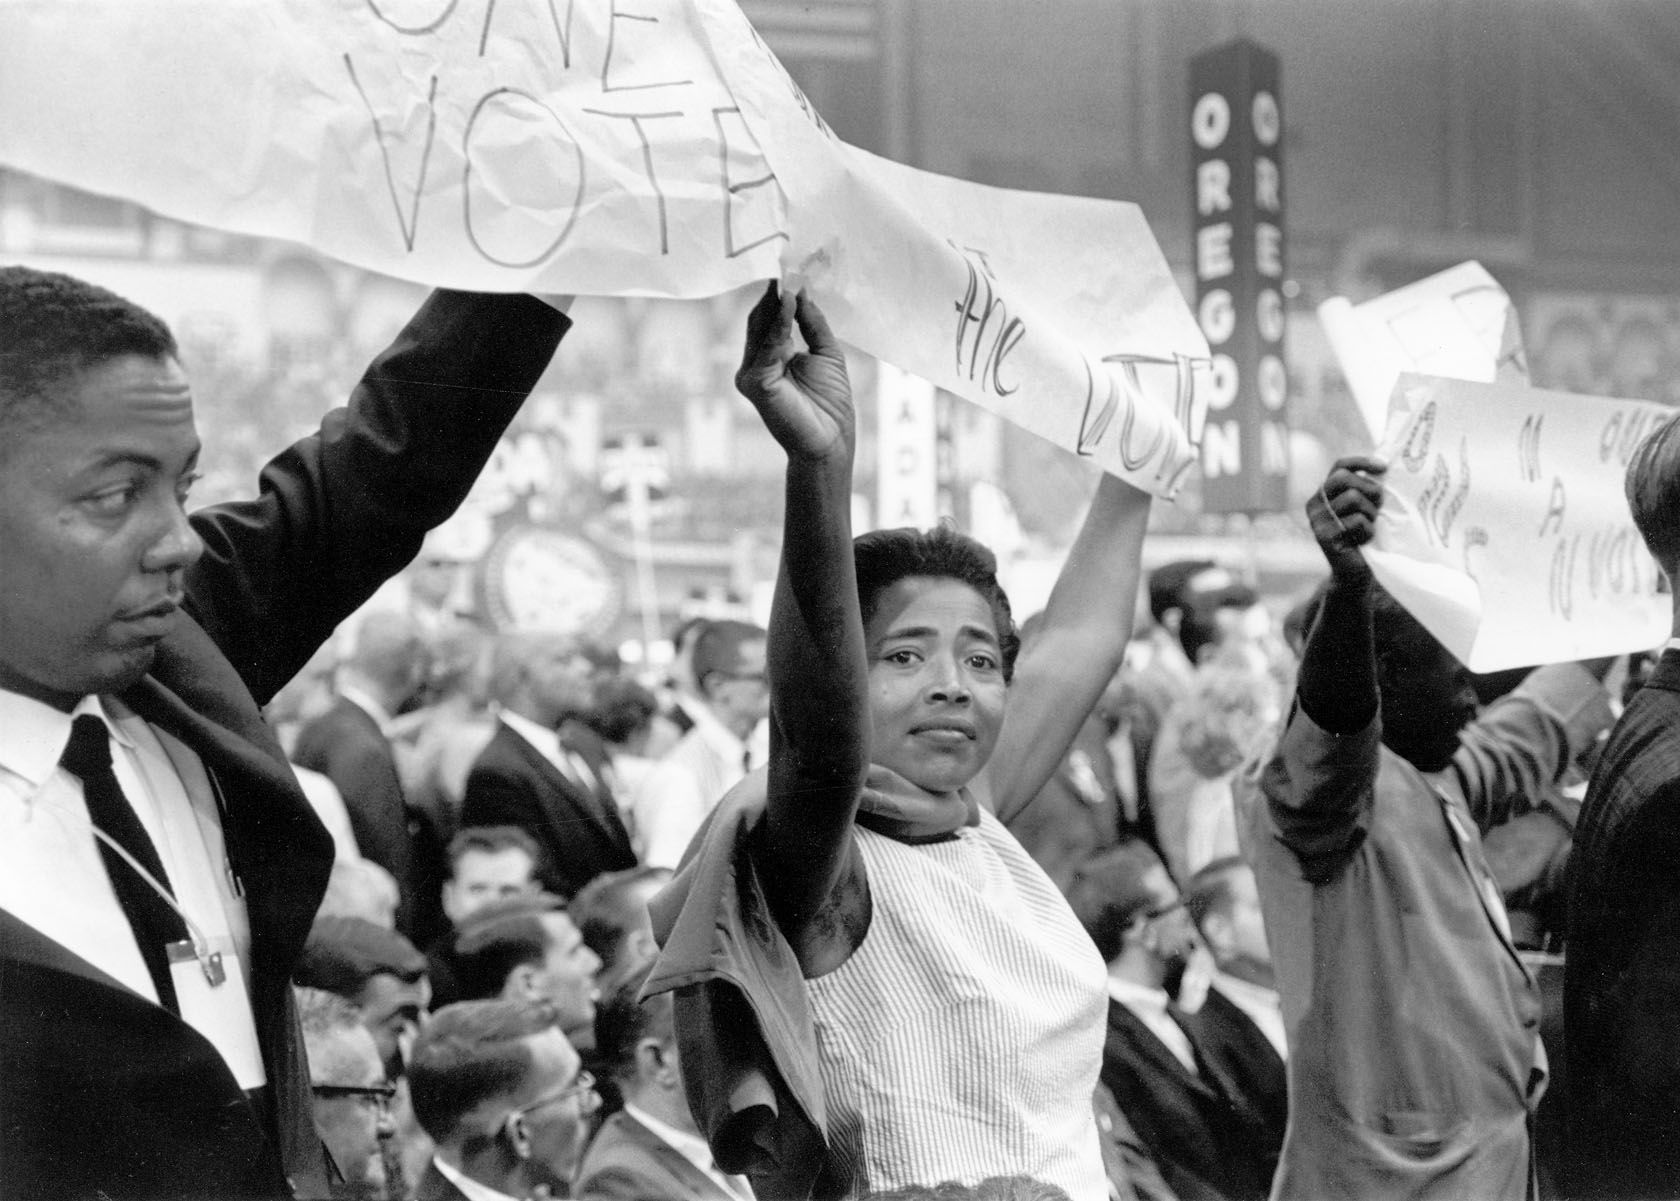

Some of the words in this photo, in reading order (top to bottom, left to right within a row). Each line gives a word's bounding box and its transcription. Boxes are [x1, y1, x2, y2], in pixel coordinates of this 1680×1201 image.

[368, 0, 694, 93] NE
[343, 51, 790, 269] VOTE
[1191, 91, 1242, 479] OREGON
[1251, 90, 1288, 478] OREGON
[895, 366, 922, 522] ADA
